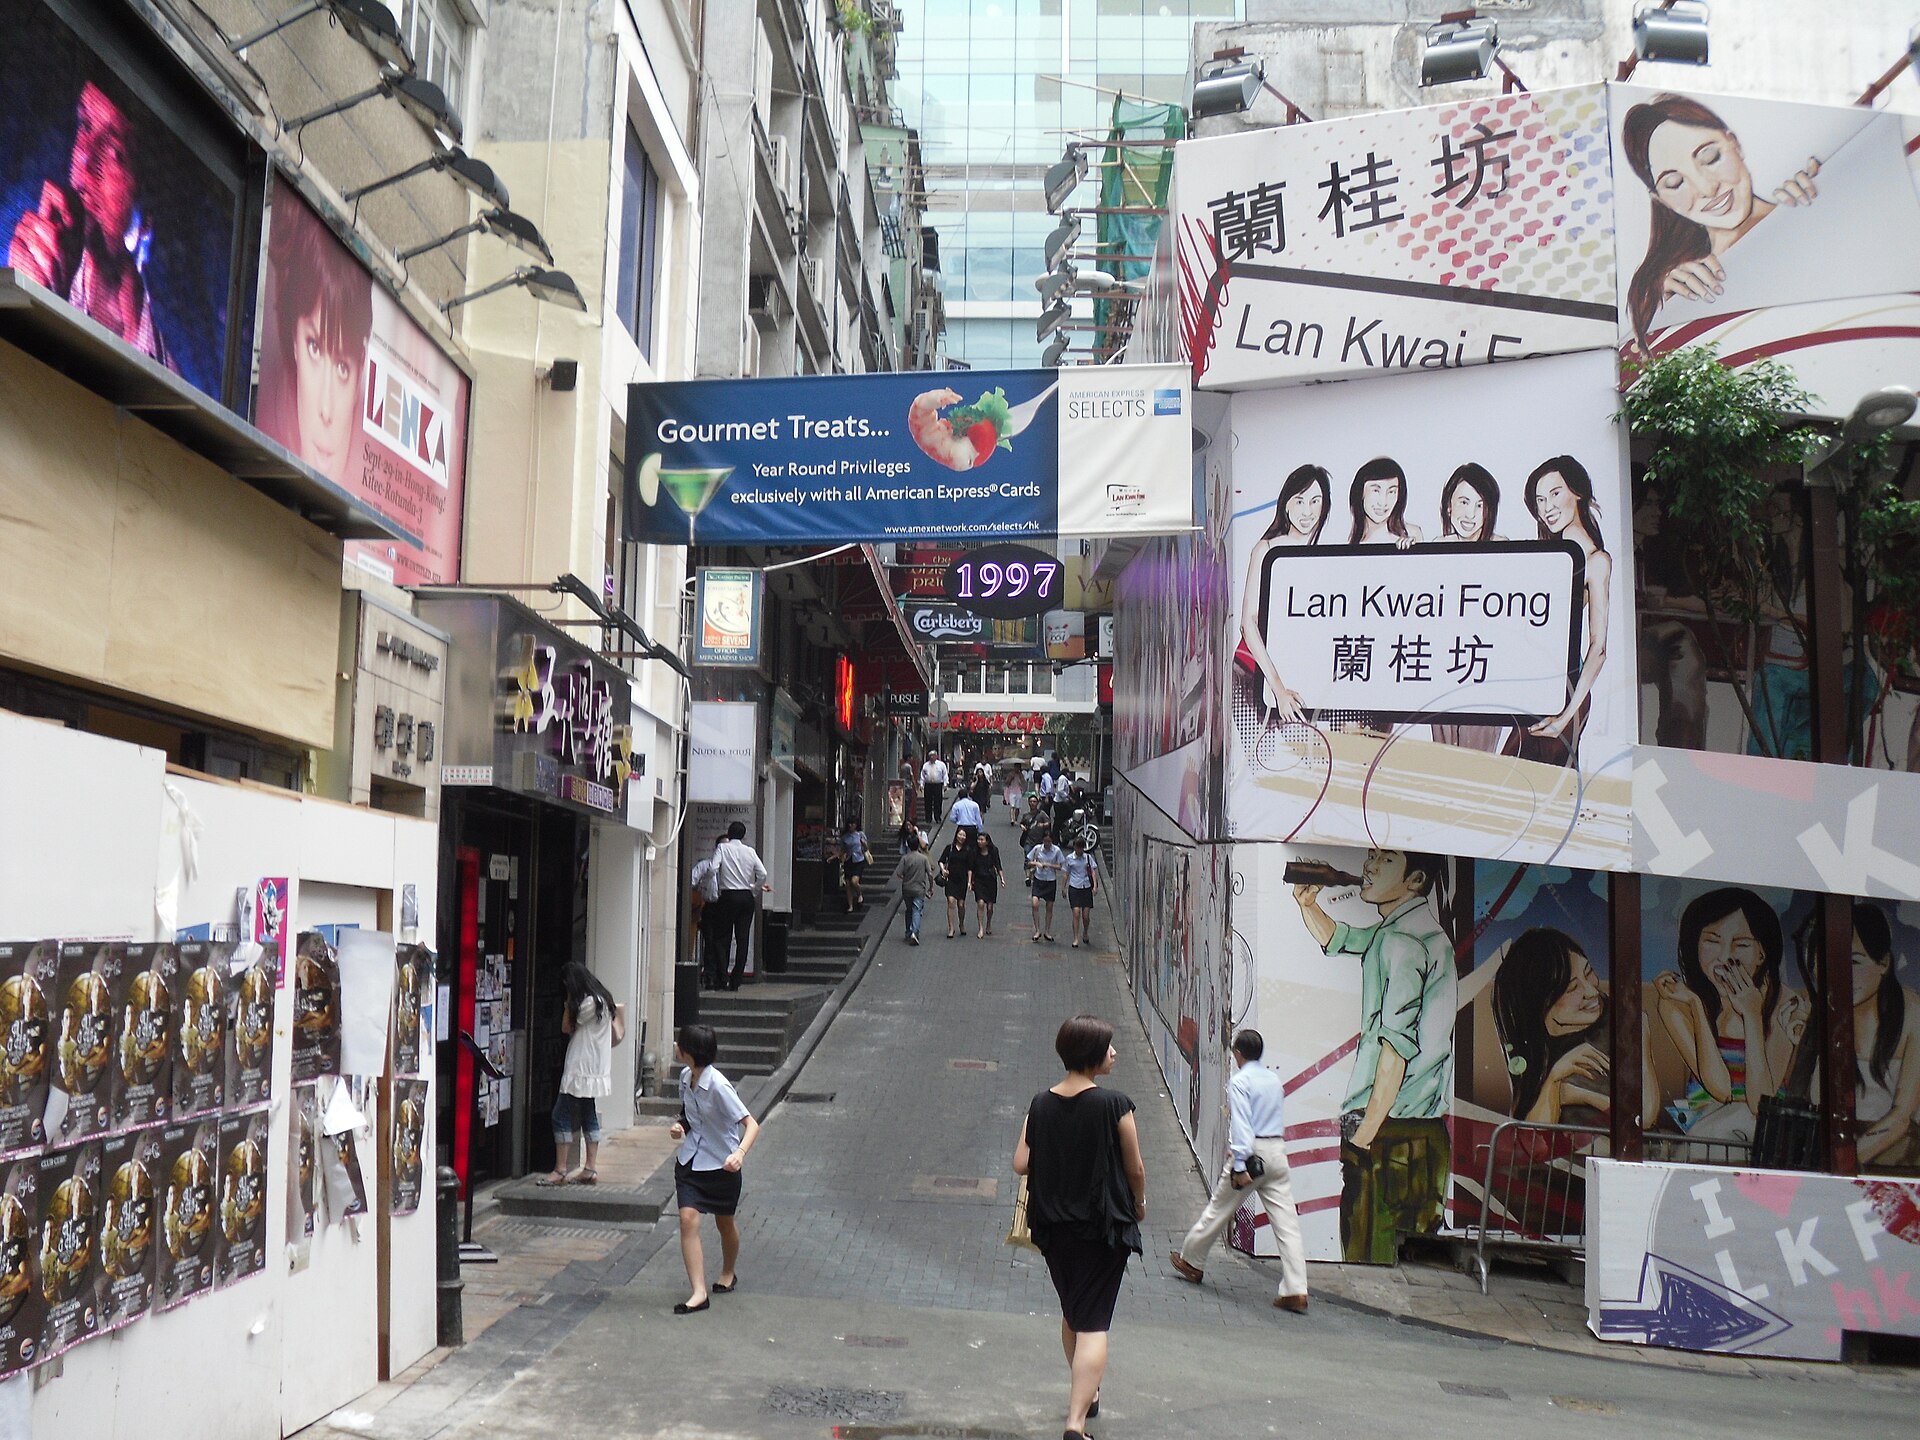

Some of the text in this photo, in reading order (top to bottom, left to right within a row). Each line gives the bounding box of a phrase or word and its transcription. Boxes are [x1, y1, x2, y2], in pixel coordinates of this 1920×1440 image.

[1207, 122, 1517, 265] 蘭桂坊
[1235, 304, 1324, 359] Lan
[1341, 316, 1467, 368] Kwai
[1069, 389, 1145, 399] AMERICAN EXPRESS
[366, 359, 448, 480] LENKA
[1068, 399, 1146, 419] SELECTS
[657, 415, 891, 443] Gourmet Treats...
[752, 458, 911, 477] Year Round Privileges
[730, 487, 806, 506] exclusively
[810, 486, 841, 502] with
[845, 486, 862, 501] all
[865, 486, 934, 501] American
[999, 481, 1041, 498] Cards
[884, 520, 1040, 534] www.amexnetwork.com/selects/hk
[956, 562, 1057, 598] 1997
[1287, 584, 1551, 627] Lan Kwai Fong
[913, 609, 982, 637] Carlsberg
[1332, 634, 1494, 684] 蘭桂坊
[890, 693, 920, 704] PURSUE
[964, 711, 1004, 732] Rock
[1690, 1178, 1736, 1240] I
